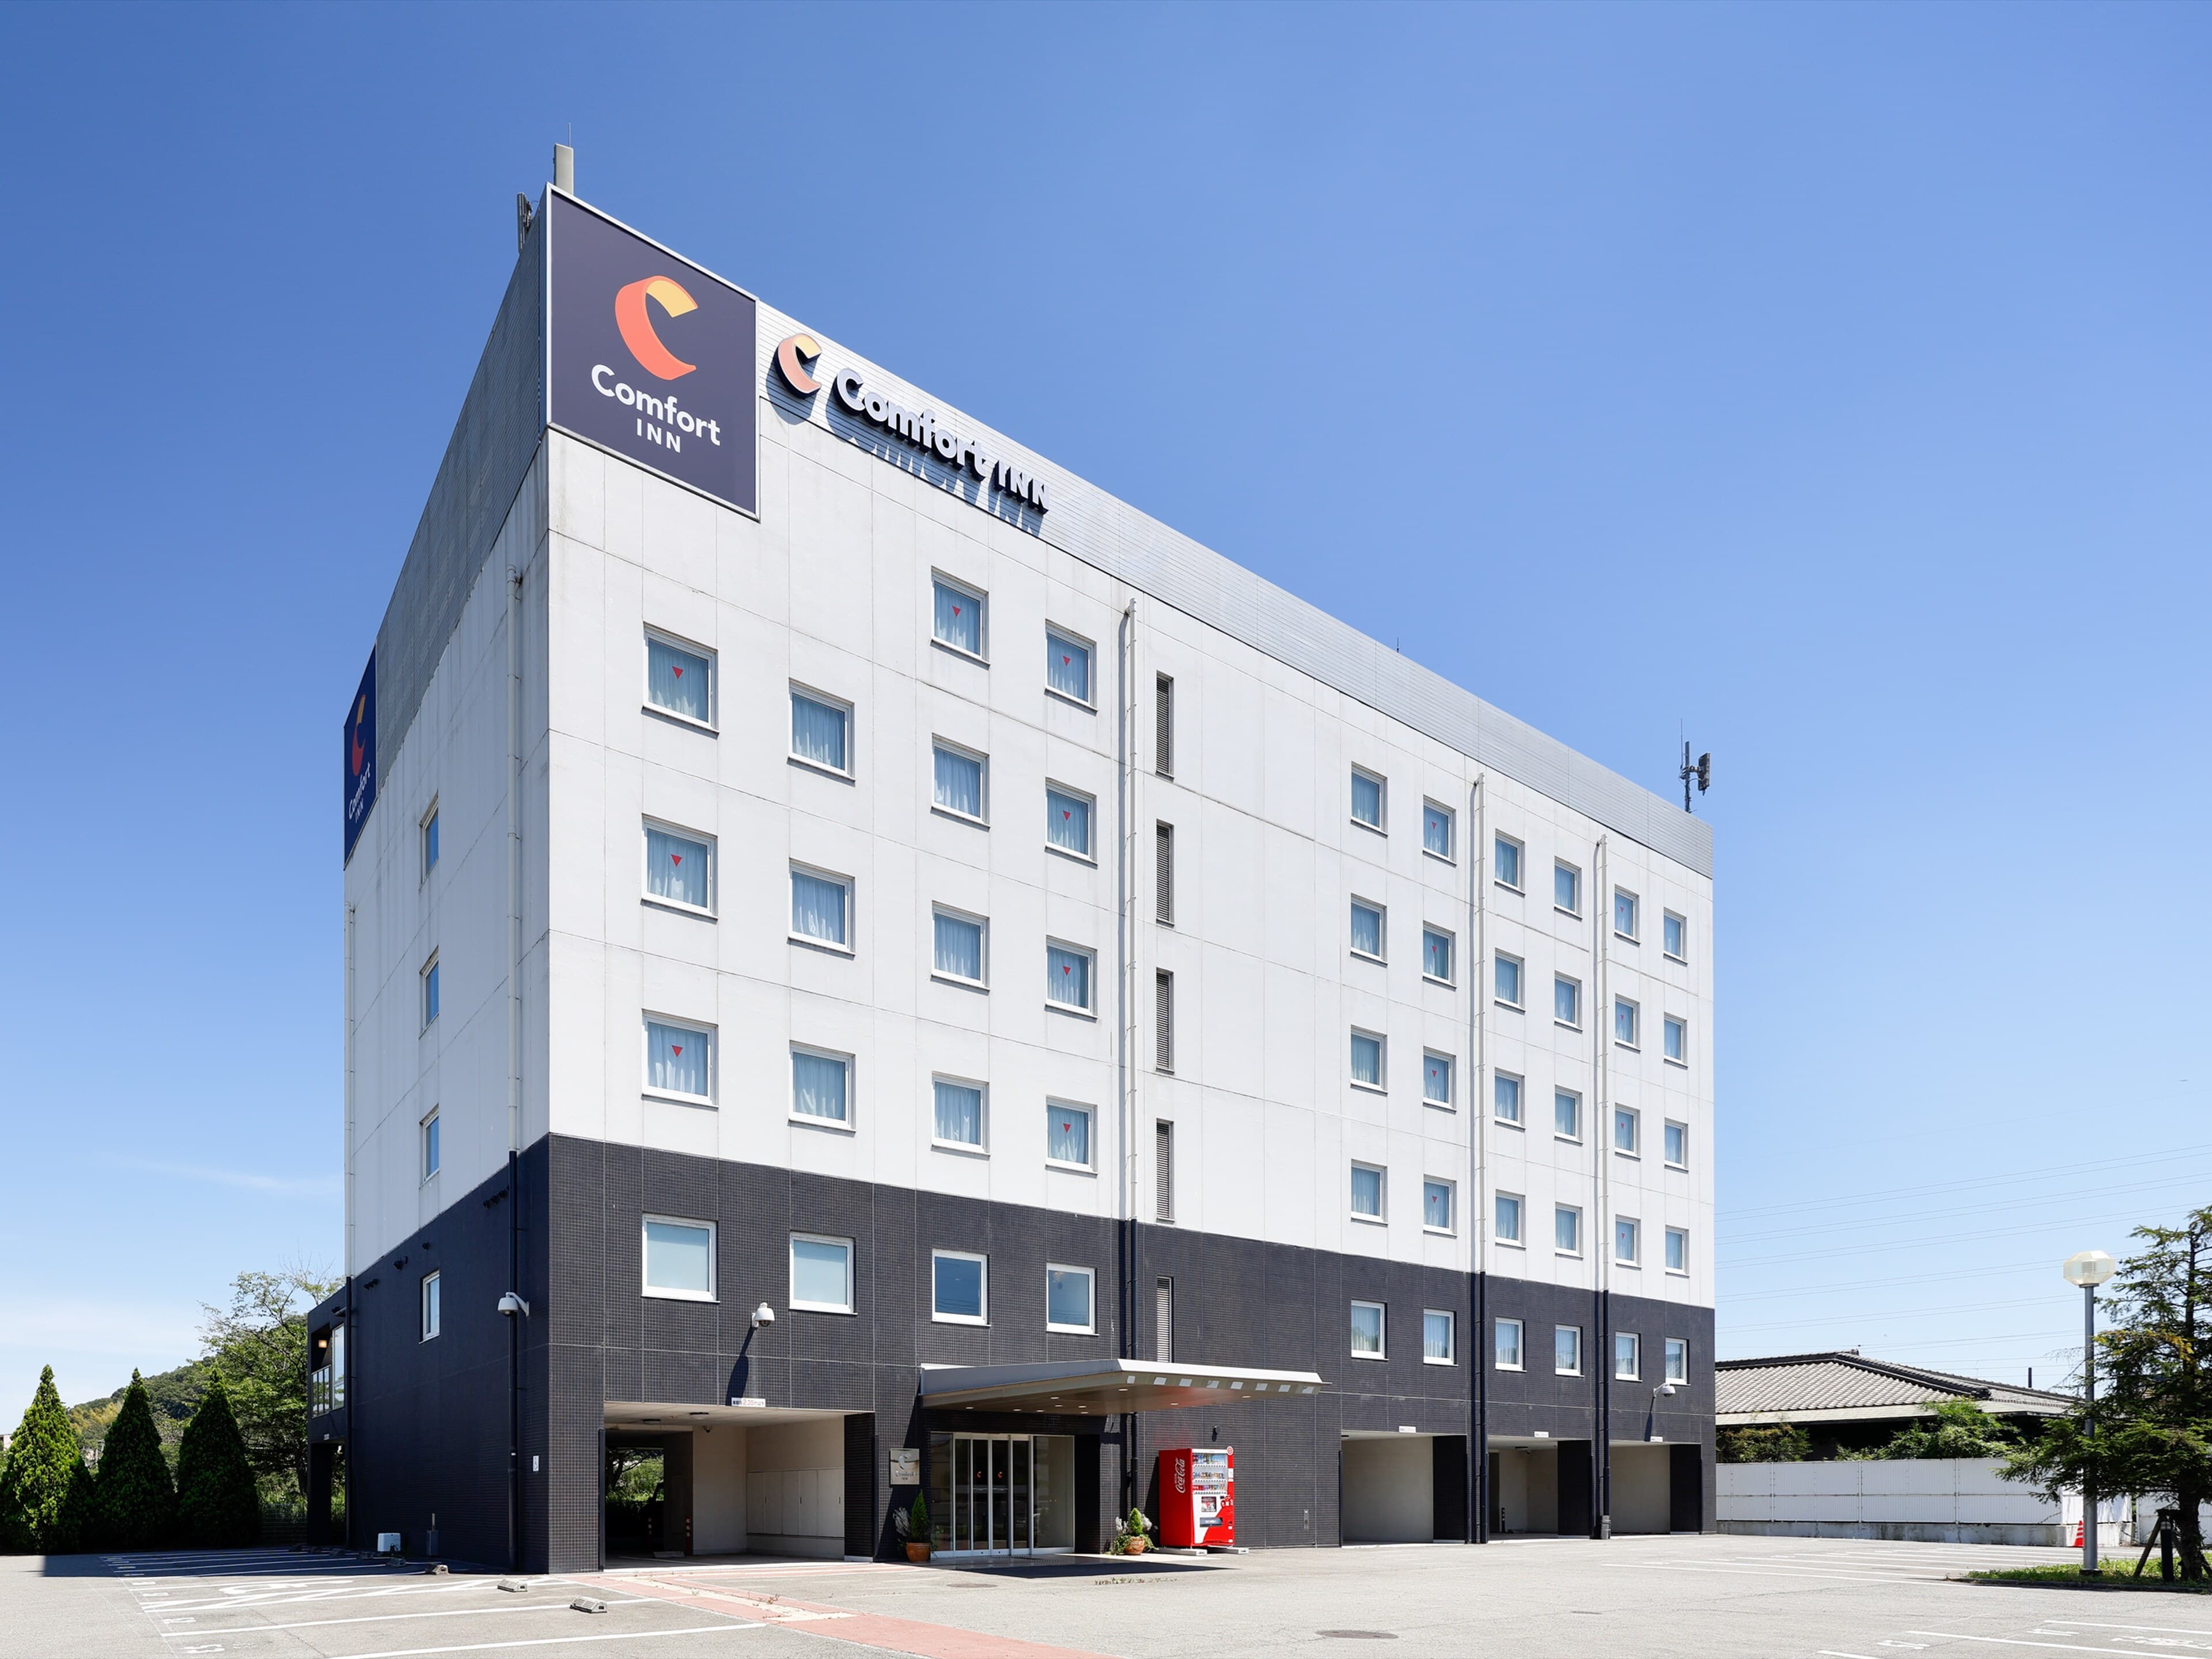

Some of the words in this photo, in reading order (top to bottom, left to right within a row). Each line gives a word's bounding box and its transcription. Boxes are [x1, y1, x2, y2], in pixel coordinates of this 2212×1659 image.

[591, 364, 721, 446] Comfort
[637, 418, 681, 453] INN
[834, 368, 987, 482] Comfort
[994, 459, 1050, 514] INN
[349, 761, 370, 820] Comfort
